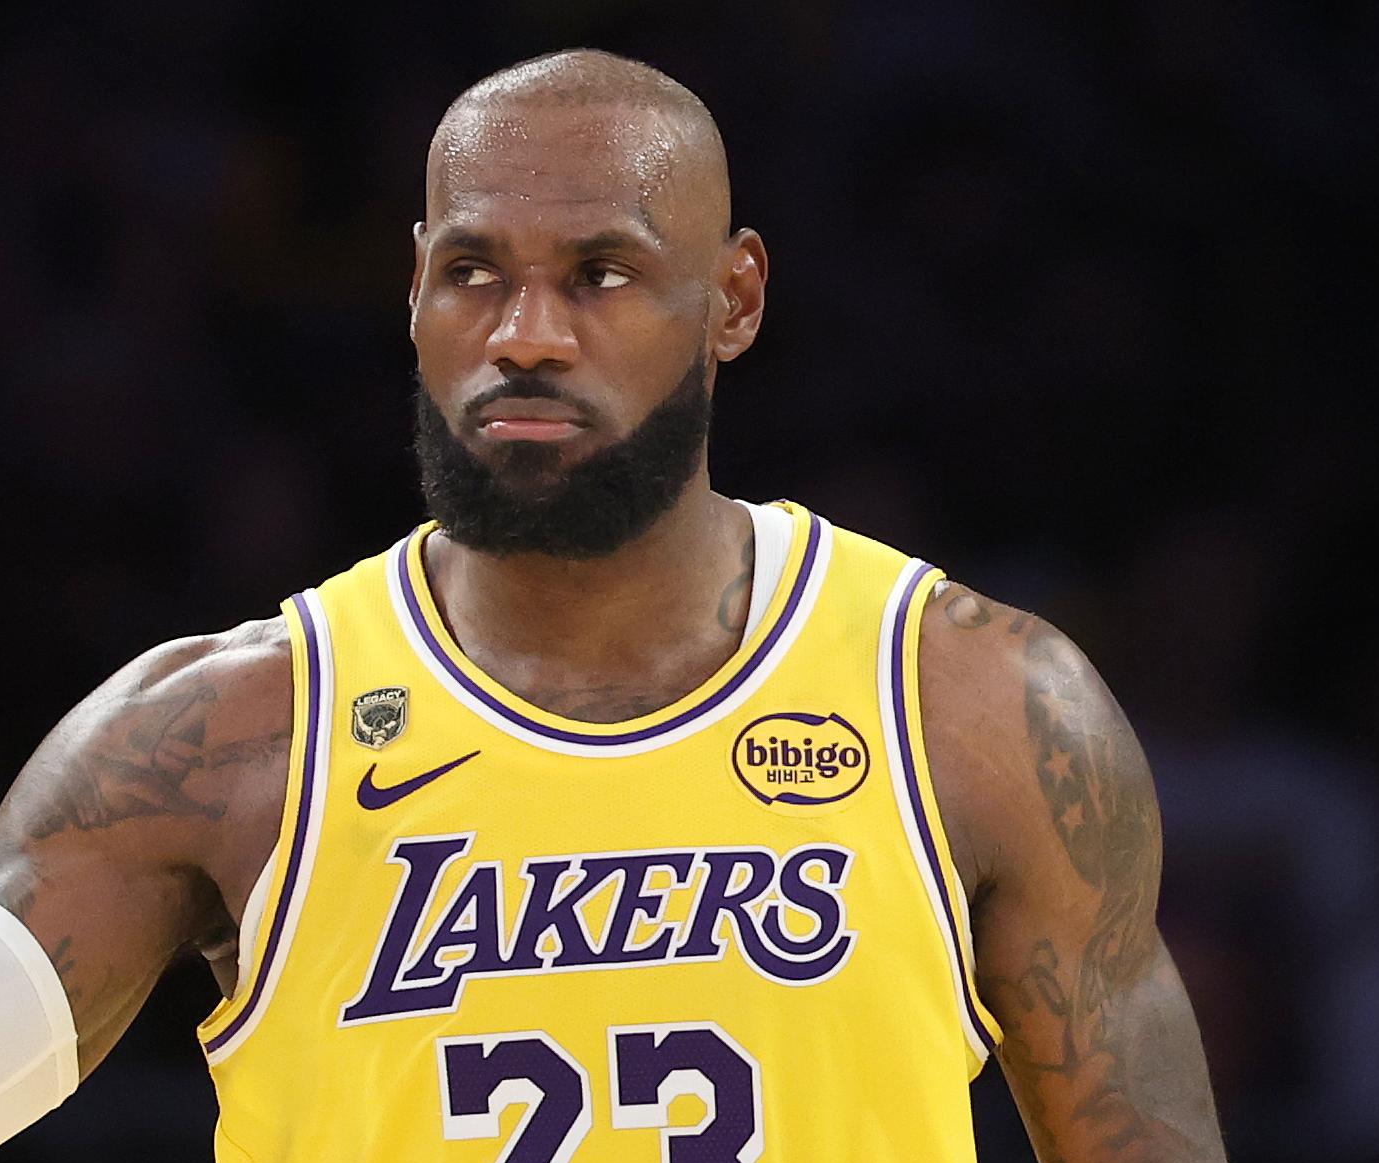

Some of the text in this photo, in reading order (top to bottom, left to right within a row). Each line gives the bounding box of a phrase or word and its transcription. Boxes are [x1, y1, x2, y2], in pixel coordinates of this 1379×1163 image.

[357, 691, 402, 705] LEGACY
[746, 736, 861, 778] bibigo
[767, 770, 815, 784] 비비고
[338, 831, 858, 1028] LAKERS
